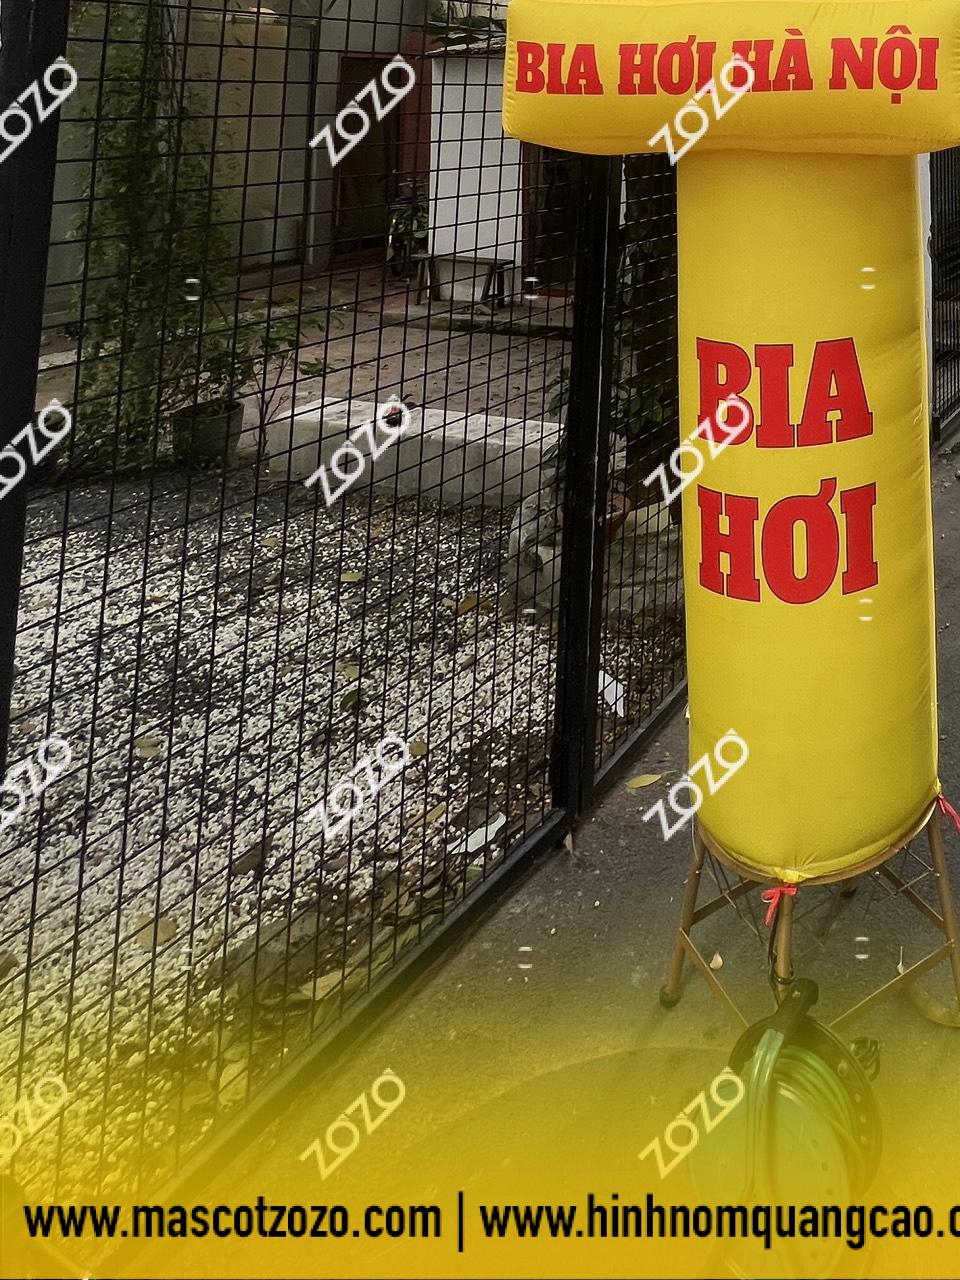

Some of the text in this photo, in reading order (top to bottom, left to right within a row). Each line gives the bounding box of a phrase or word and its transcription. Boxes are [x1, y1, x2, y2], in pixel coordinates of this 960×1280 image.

[515, 24, 940, 105] BIA HƠI HÀ NỘI
[696, 337, 874, 448] BIA
[697, 477, 879, 605] HƠI
